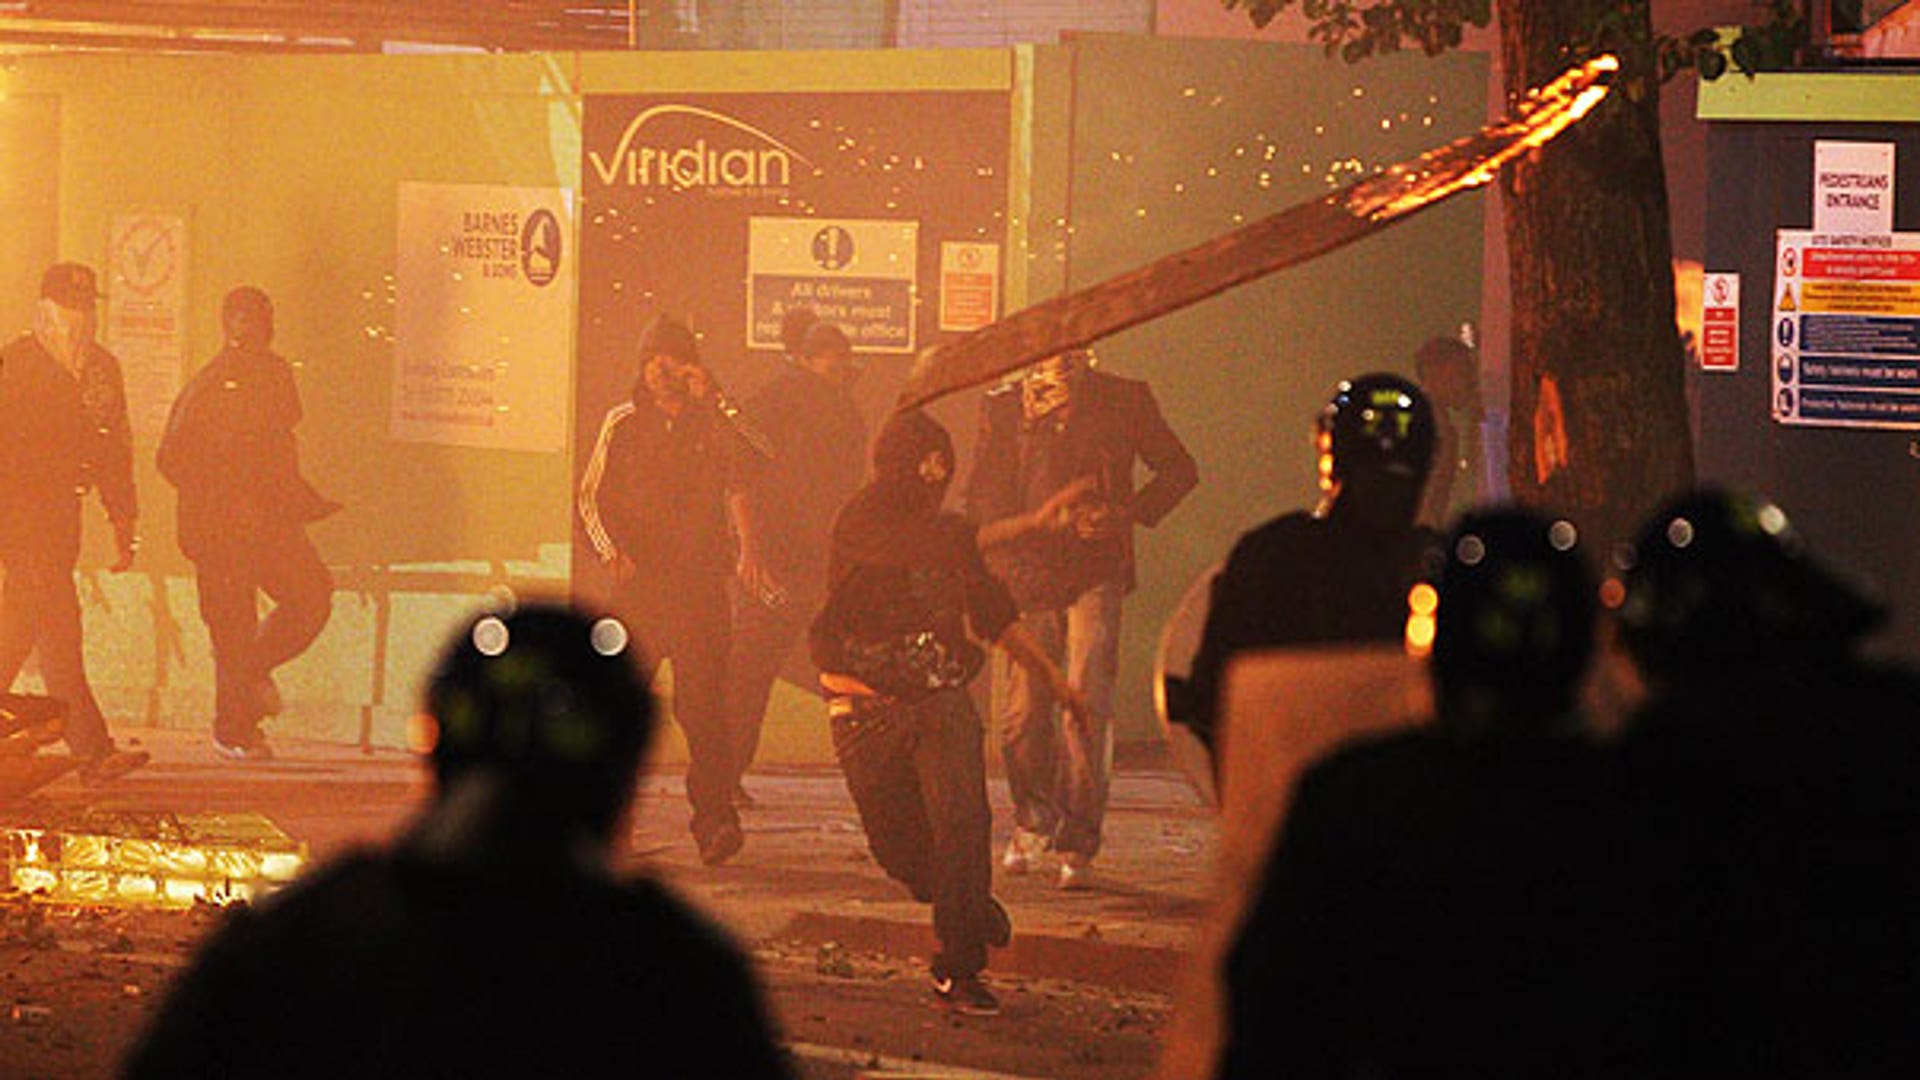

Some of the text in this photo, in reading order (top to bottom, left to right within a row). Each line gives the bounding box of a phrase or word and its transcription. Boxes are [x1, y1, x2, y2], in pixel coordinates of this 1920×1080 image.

[1821, 173, 1888, 190] PEDESTRIANS
[1826, 193, 1879, 210] ENTRANCE
[464, 212, 518, 235] BARNES
[450, 236, 516, 259] WEBSTER
[791, 282, 872, 298] All drivers
[851, 304, 891, 318] must
